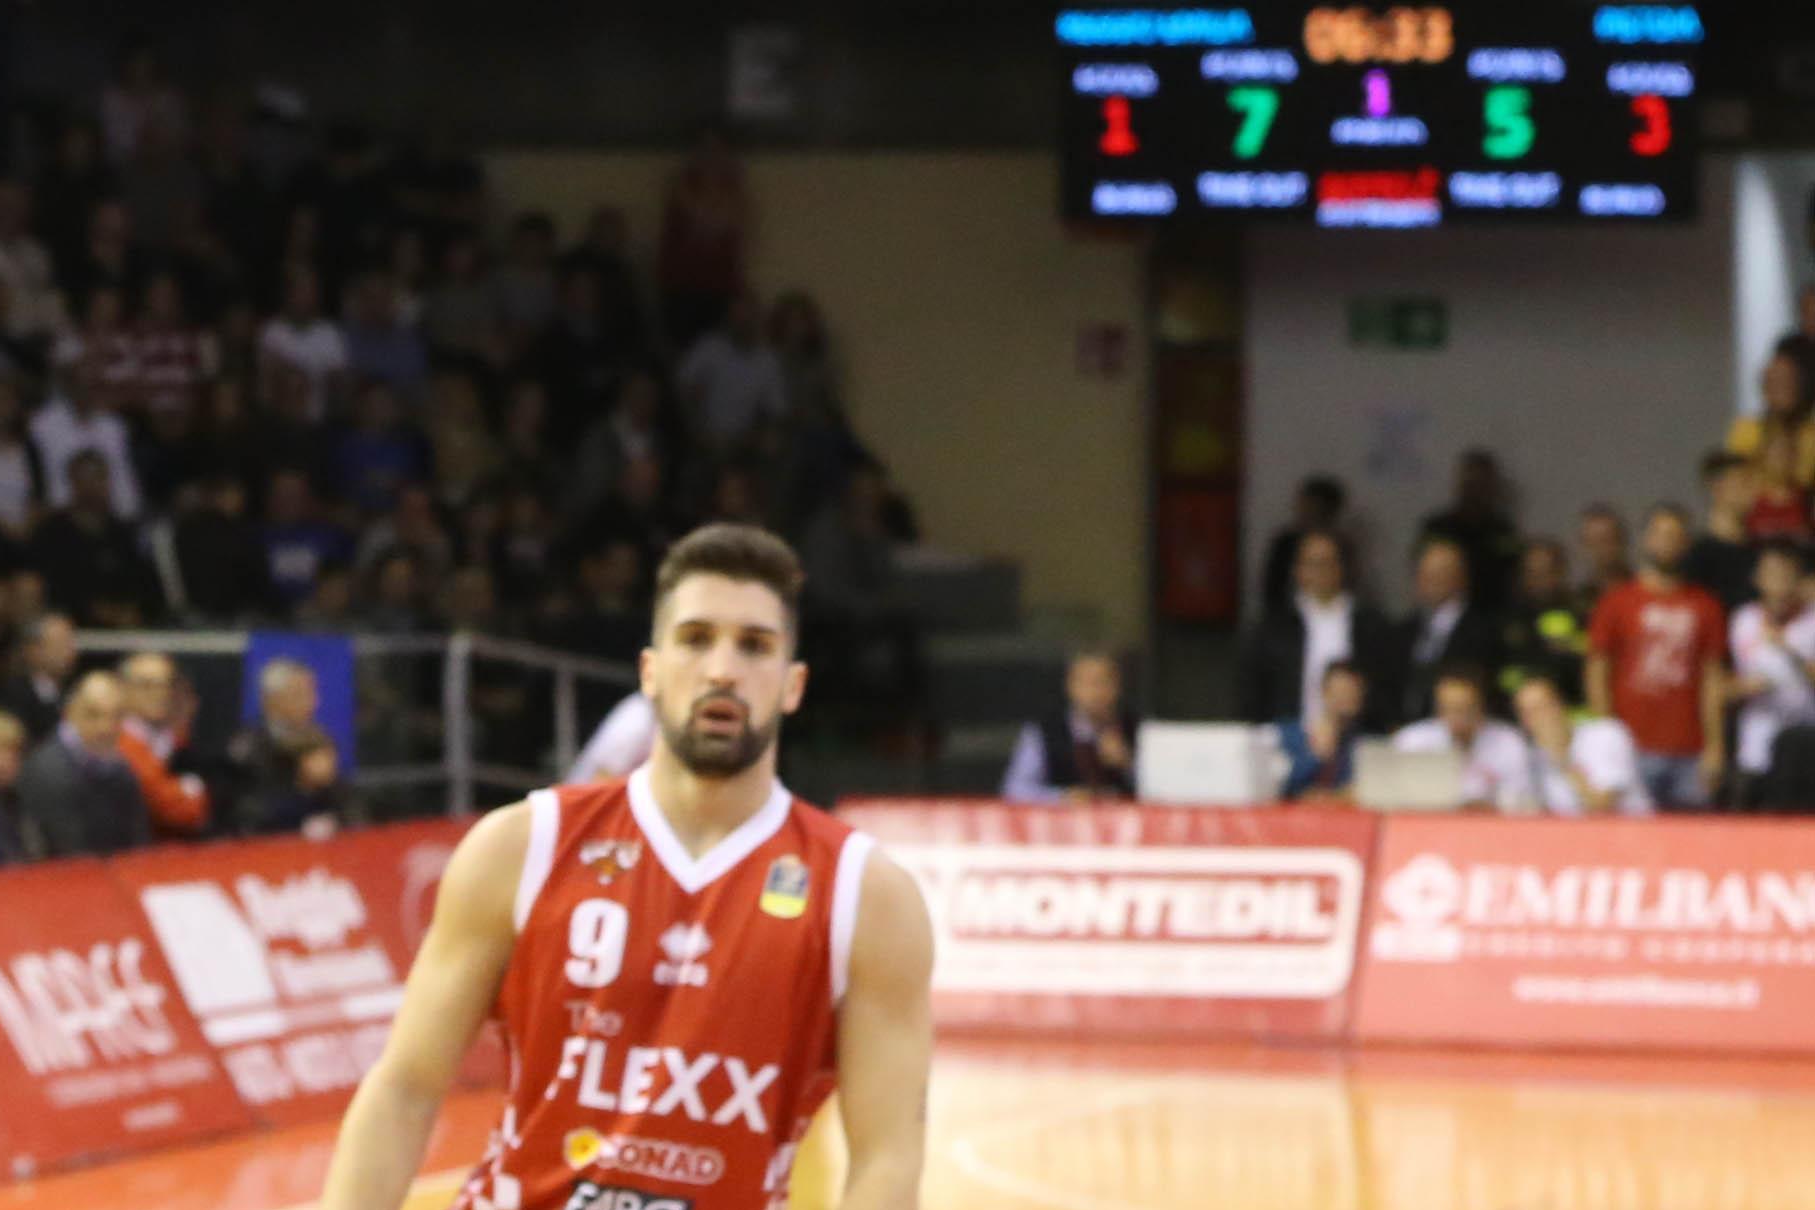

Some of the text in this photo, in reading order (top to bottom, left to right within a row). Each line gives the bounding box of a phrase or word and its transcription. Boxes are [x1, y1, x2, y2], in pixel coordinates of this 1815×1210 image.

[1100, 94, 1139, 156] 1
[1226, 84, 1279, 159] 7
[1483, 84, 1536, 159] 5
[1629, 93, 1673, 156] 3
[564, 898, 629, 988] 9
[547, 1036, 782, 1134] FLEXX
